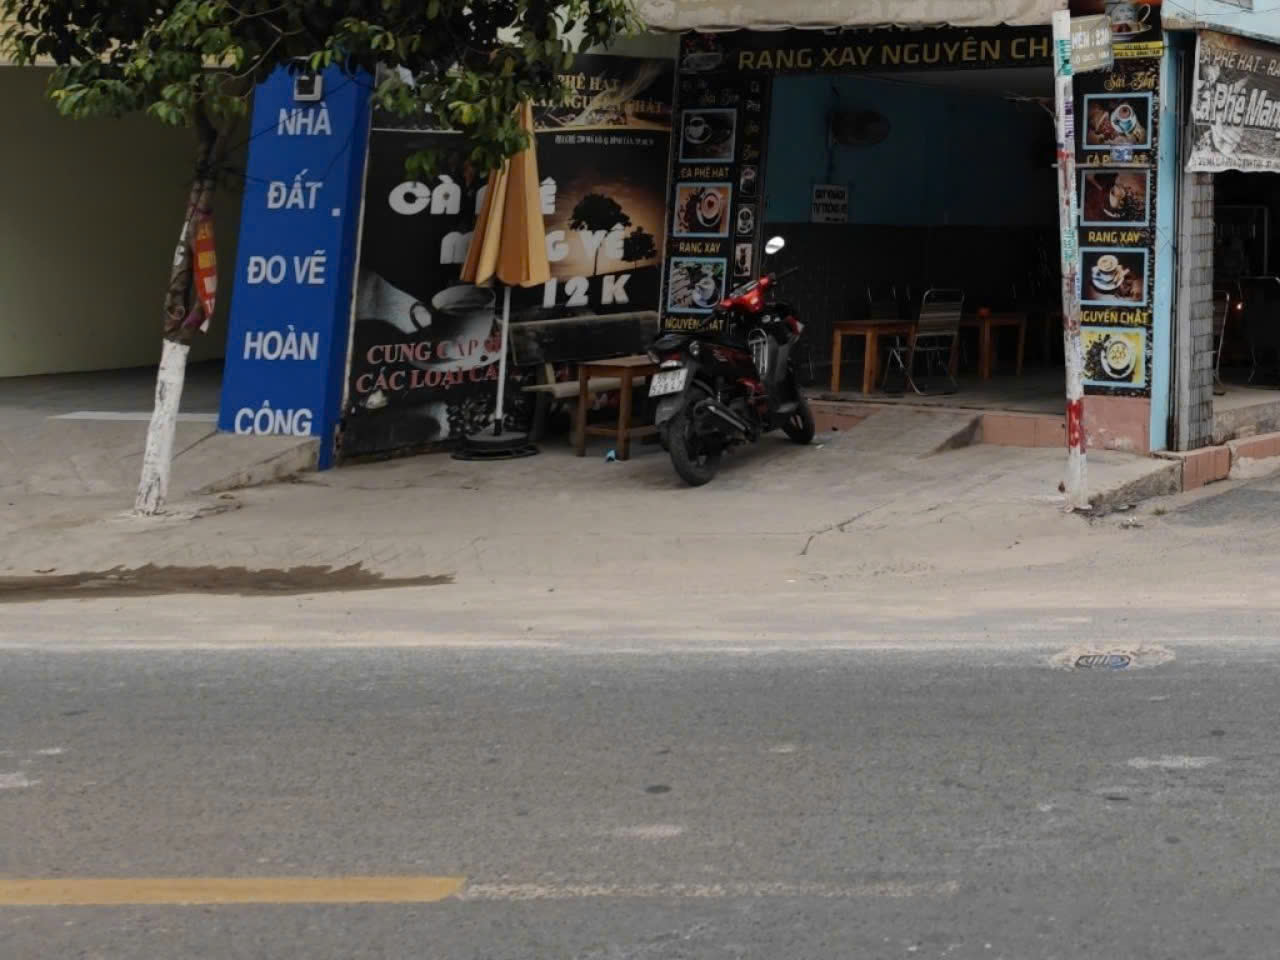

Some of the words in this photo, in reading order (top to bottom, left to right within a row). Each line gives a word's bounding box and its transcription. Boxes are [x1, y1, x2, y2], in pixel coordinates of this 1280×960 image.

[737, 49, 812, 72] RANG
[822, 45, 873, 68] XAY
[881, 35, 1001, 65] NGUYÊN
[1010, 37, 1056, 59] CH
[278, 101, 332, 136] NHÀ
[267, 169, 323, 210] ĐẤT
[388, 175, 461, 216] CÀ
[679, 241, 701, 253] RANG
[703, 241, 721, 253] XAY
[1088, 231, 1118, 243] RANG
[1119, 231, 1140, 243] XAY
[248, 255, 287, 285] ĐO
[293, 249, 328, 285] VẼ
[243, 324, 319, 361] HOÀN
[366, 341, 431, 365] CUNG
[356, 366, 406, 393] CÁC
[409, 368, 464, 390] LOẠI
[234, 399, 313, 437] CÔNG
